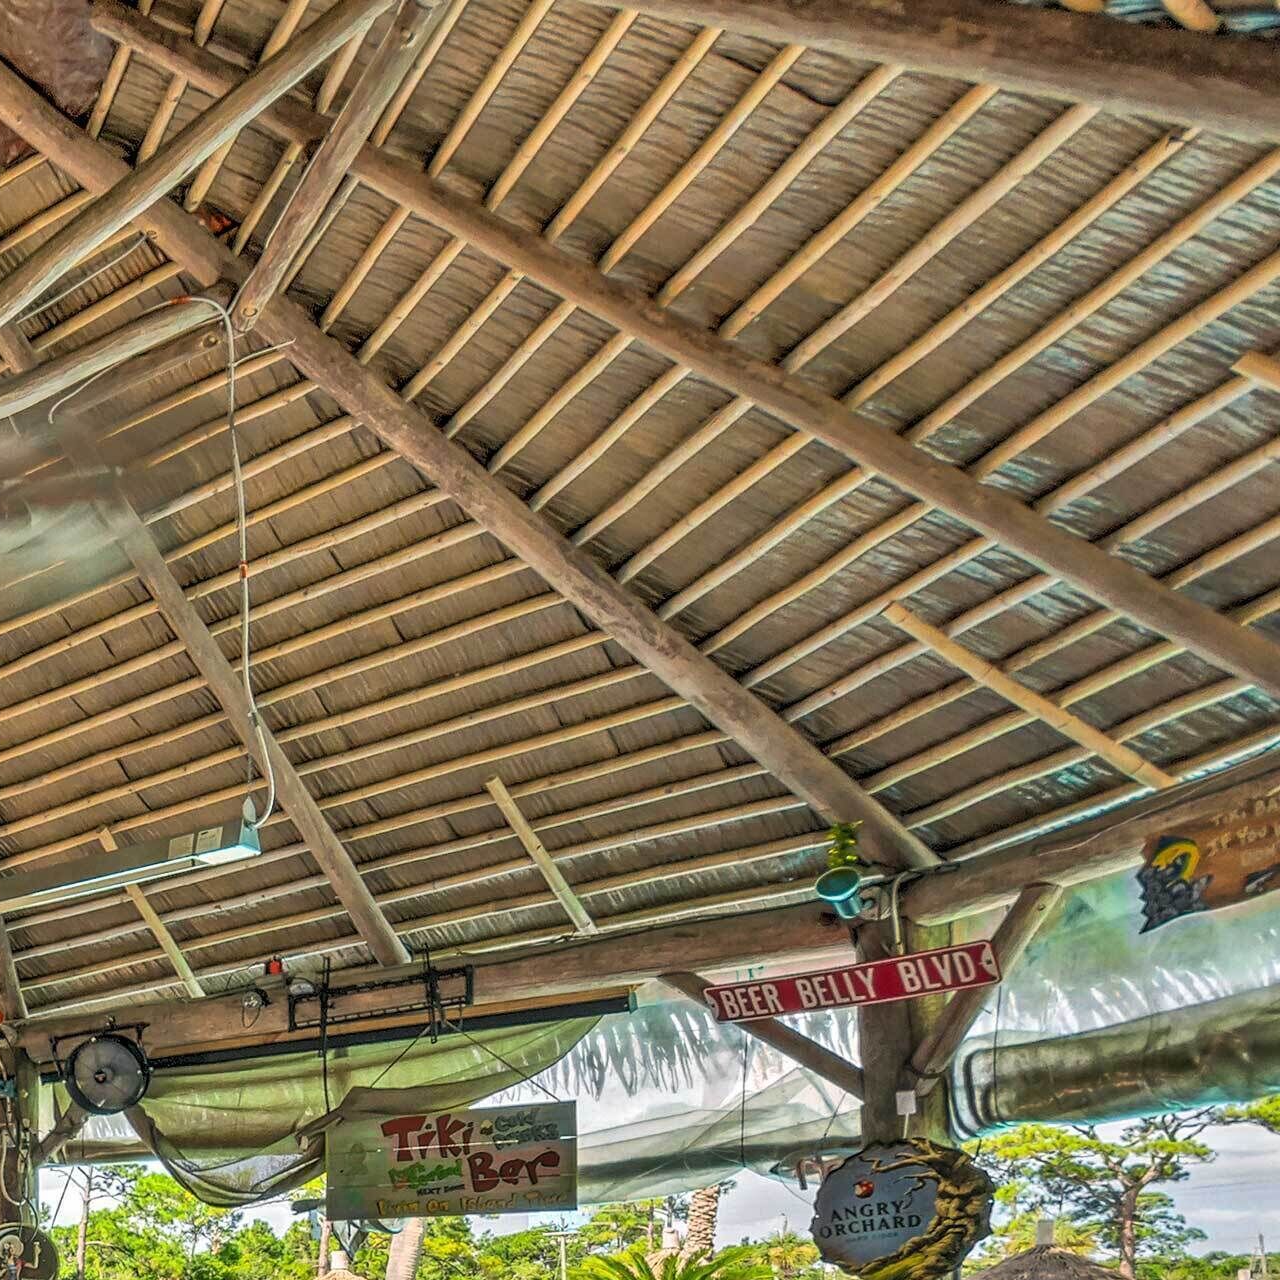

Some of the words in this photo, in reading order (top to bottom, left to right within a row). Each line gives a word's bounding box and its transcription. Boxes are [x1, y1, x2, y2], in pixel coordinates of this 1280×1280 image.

[720, 983, 785, 1019] BEER
[794, 967, 878, 1009] BELLY
[896, 950, 976, 993] BLVD
[831, 1199, 906, 1223] ANGRY
[819, 1214, 923, 1240] ORCHARD
